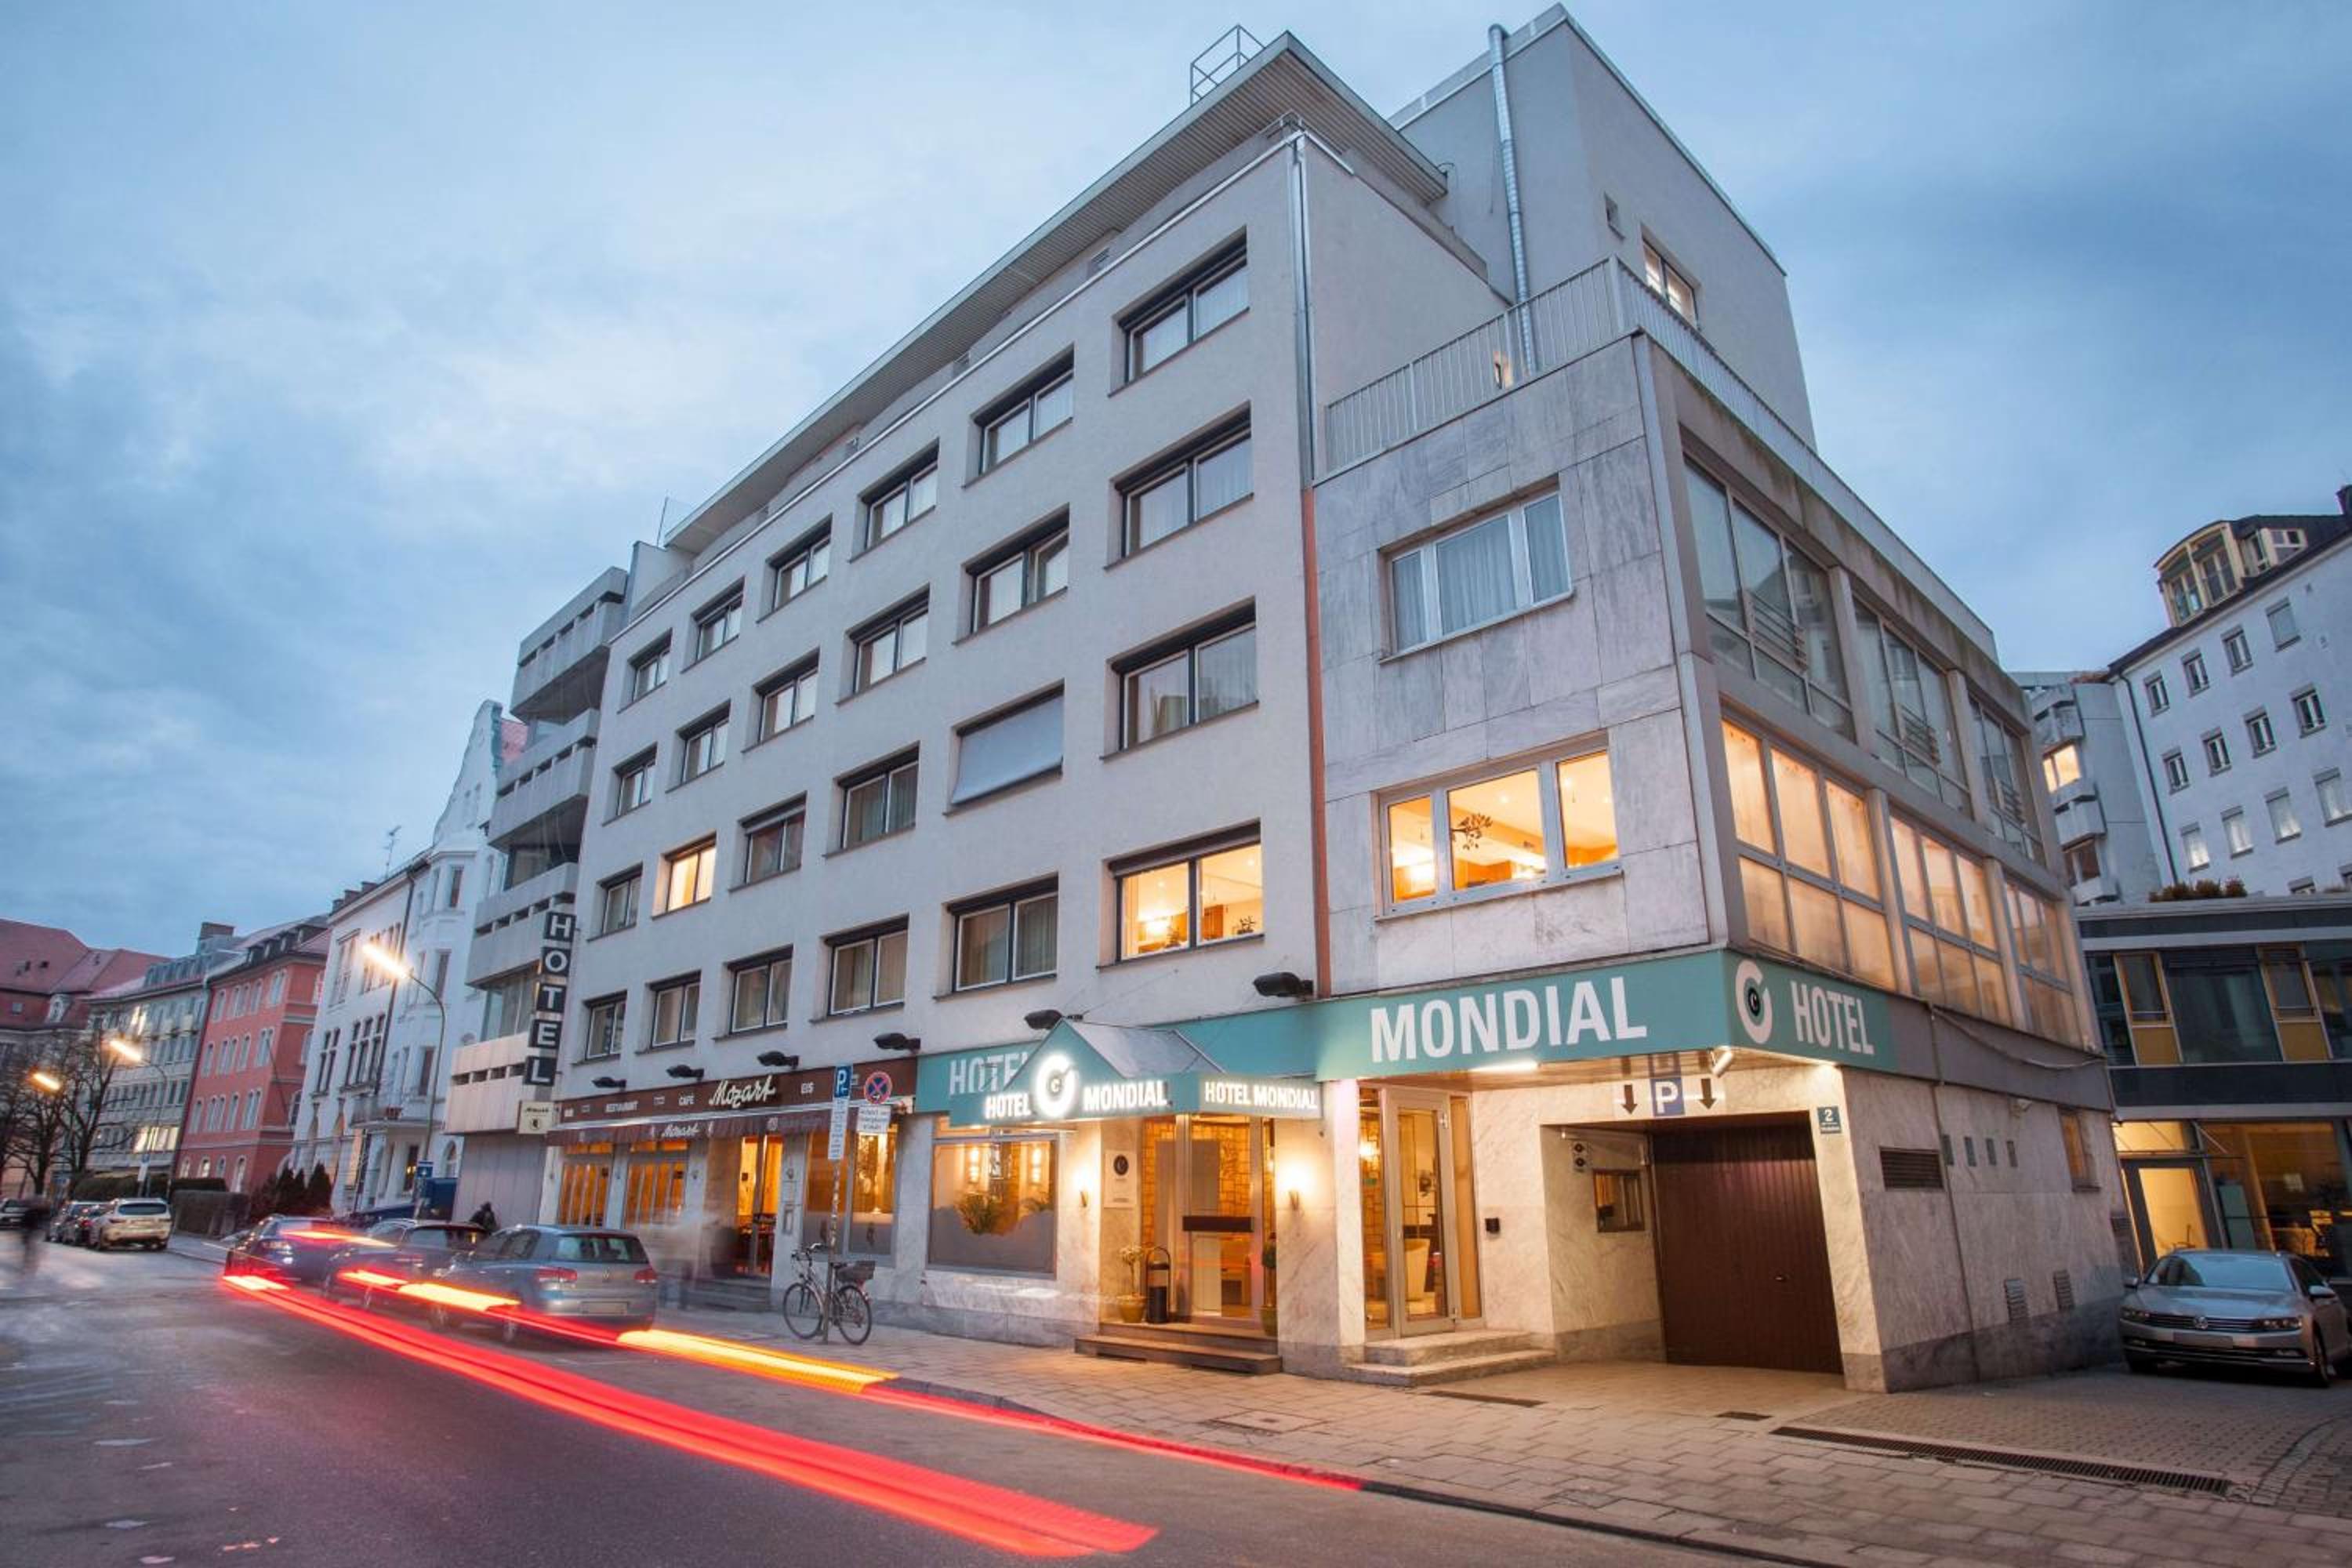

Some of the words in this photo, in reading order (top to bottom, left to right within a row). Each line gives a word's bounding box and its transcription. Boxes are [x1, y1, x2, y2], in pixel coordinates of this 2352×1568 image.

[529, 915, 572, 1083] HOTEL
[1790, 979, 1875, 1054] HOTEL
[1370, 976, 1647, 1063] MONDIAL
[709, 1074, 776, 1109] Mozart
[949, 1051, 1029, 1096] HOTE
[985, 1092, 1032, 1120] HOTEL
[1083, 1080, 1168, 1110] MONDIAL
[1204, 1081, 1250, 1105] HOTEL
[1254, 1084, 1318, 1109] MONDIAL
[1655, 1081, 1679, 1114] P
[1824, 1109, 1833, 1121] 2
